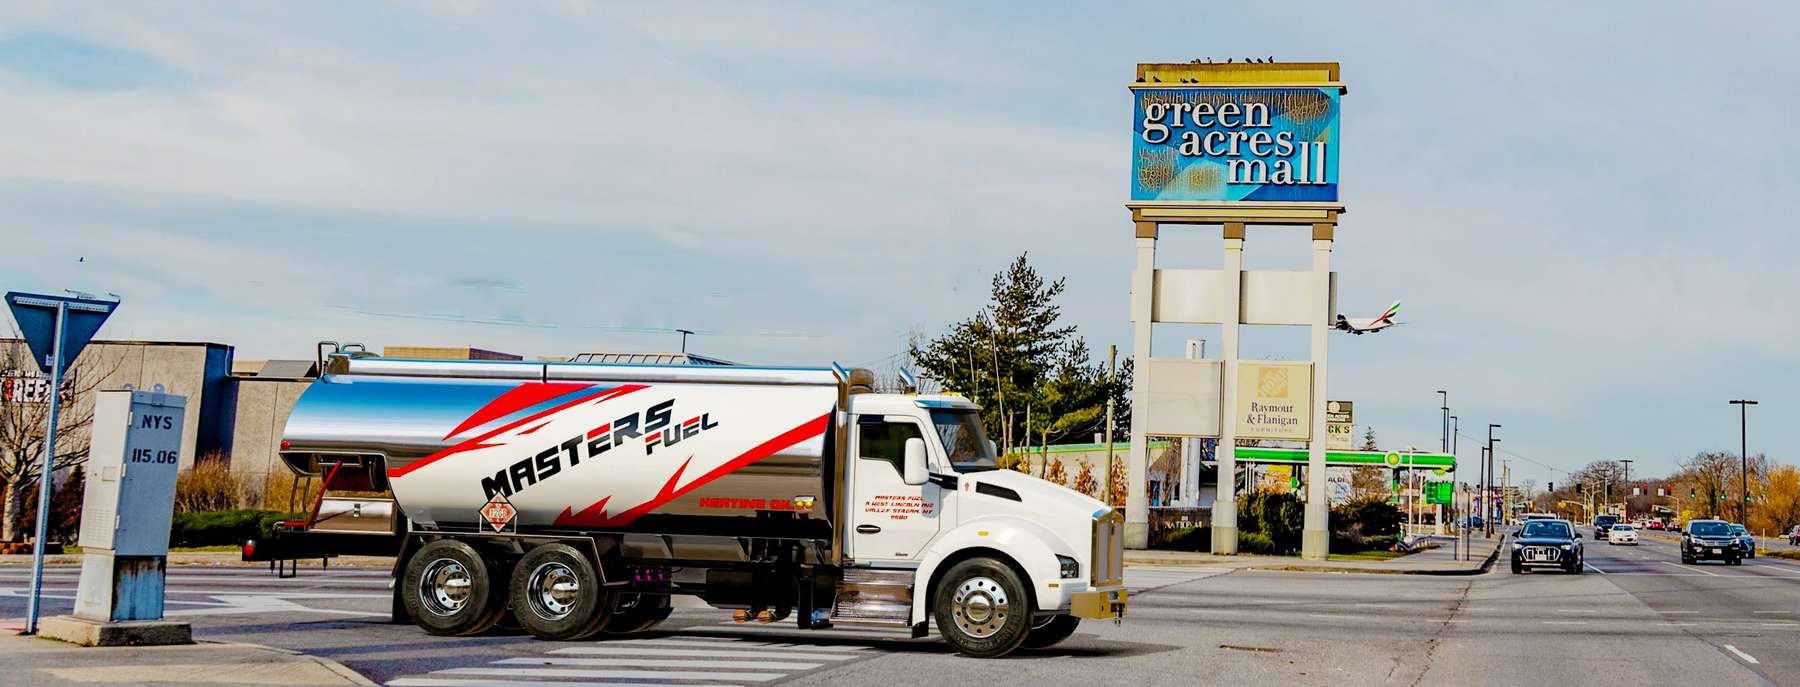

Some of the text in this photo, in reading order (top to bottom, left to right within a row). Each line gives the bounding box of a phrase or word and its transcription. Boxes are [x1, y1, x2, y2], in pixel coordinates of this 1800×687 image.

[1142, 102, 1271, 143] green
[1179, 130, 1294, 156] acres
[1226, 141, 1328, 184] mall
[1251, 402, 1295, 415] Raymour
[142, 414, 173, 430] NYS
[1246, 414, 1298, 426] & Flanigan
[1327, 424, 1350, 434] CK'S
[645, 412, 719, 456] FUEL
[132, 448, 177, 464] 115.06
[481, 398, 676, 500] MASTERS
